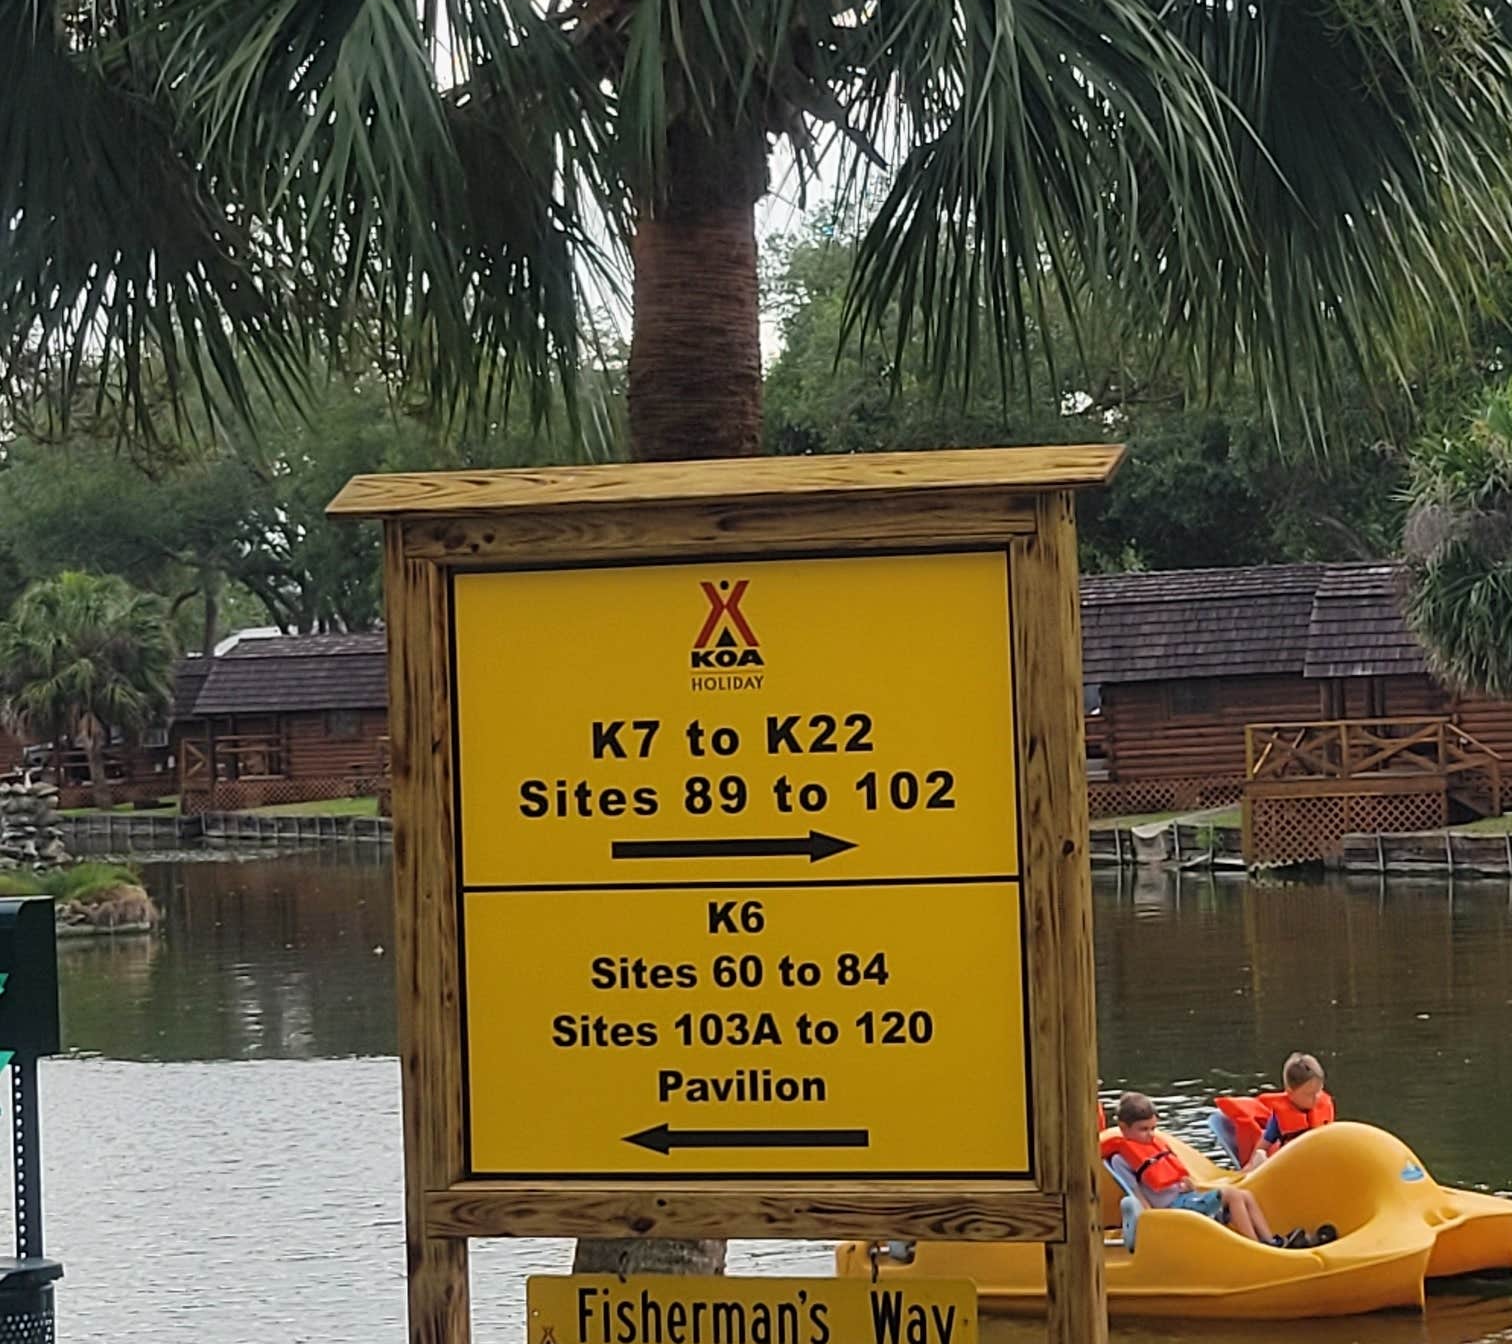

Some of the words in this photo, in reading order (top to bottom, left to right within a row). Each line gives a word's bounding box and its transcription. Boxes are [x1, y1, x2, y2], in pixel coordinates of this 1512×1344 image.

[691, 649, 765, 669] KOA
[691, 675, 764, 692] HOLIDAY
[592, 720, 660, 759] K7
[685, 719, 740, 757] to
[766, 713, 874, 755] K22
[519, 779, 659, 818] Sites
[684, 775, 747, 815] 89
[773, 775, 828, 813] to
[855, 770, 956, 811] 102
[708, 900, 765, 934] K6
[591, 957, 698, 990] Sites
[712, 954, 763, 988] 60
[778, 955, 821, 987] to
[837, 952, 889, 986] 84
[552, 1014, 658, 1047] Sites
[674, 1012, 783, 1046] 103A
[795, 1013, 839, 1046] to
[855, 1010, 933, 1044] 120
[658, 1069, 826, 1103] Pavilion
